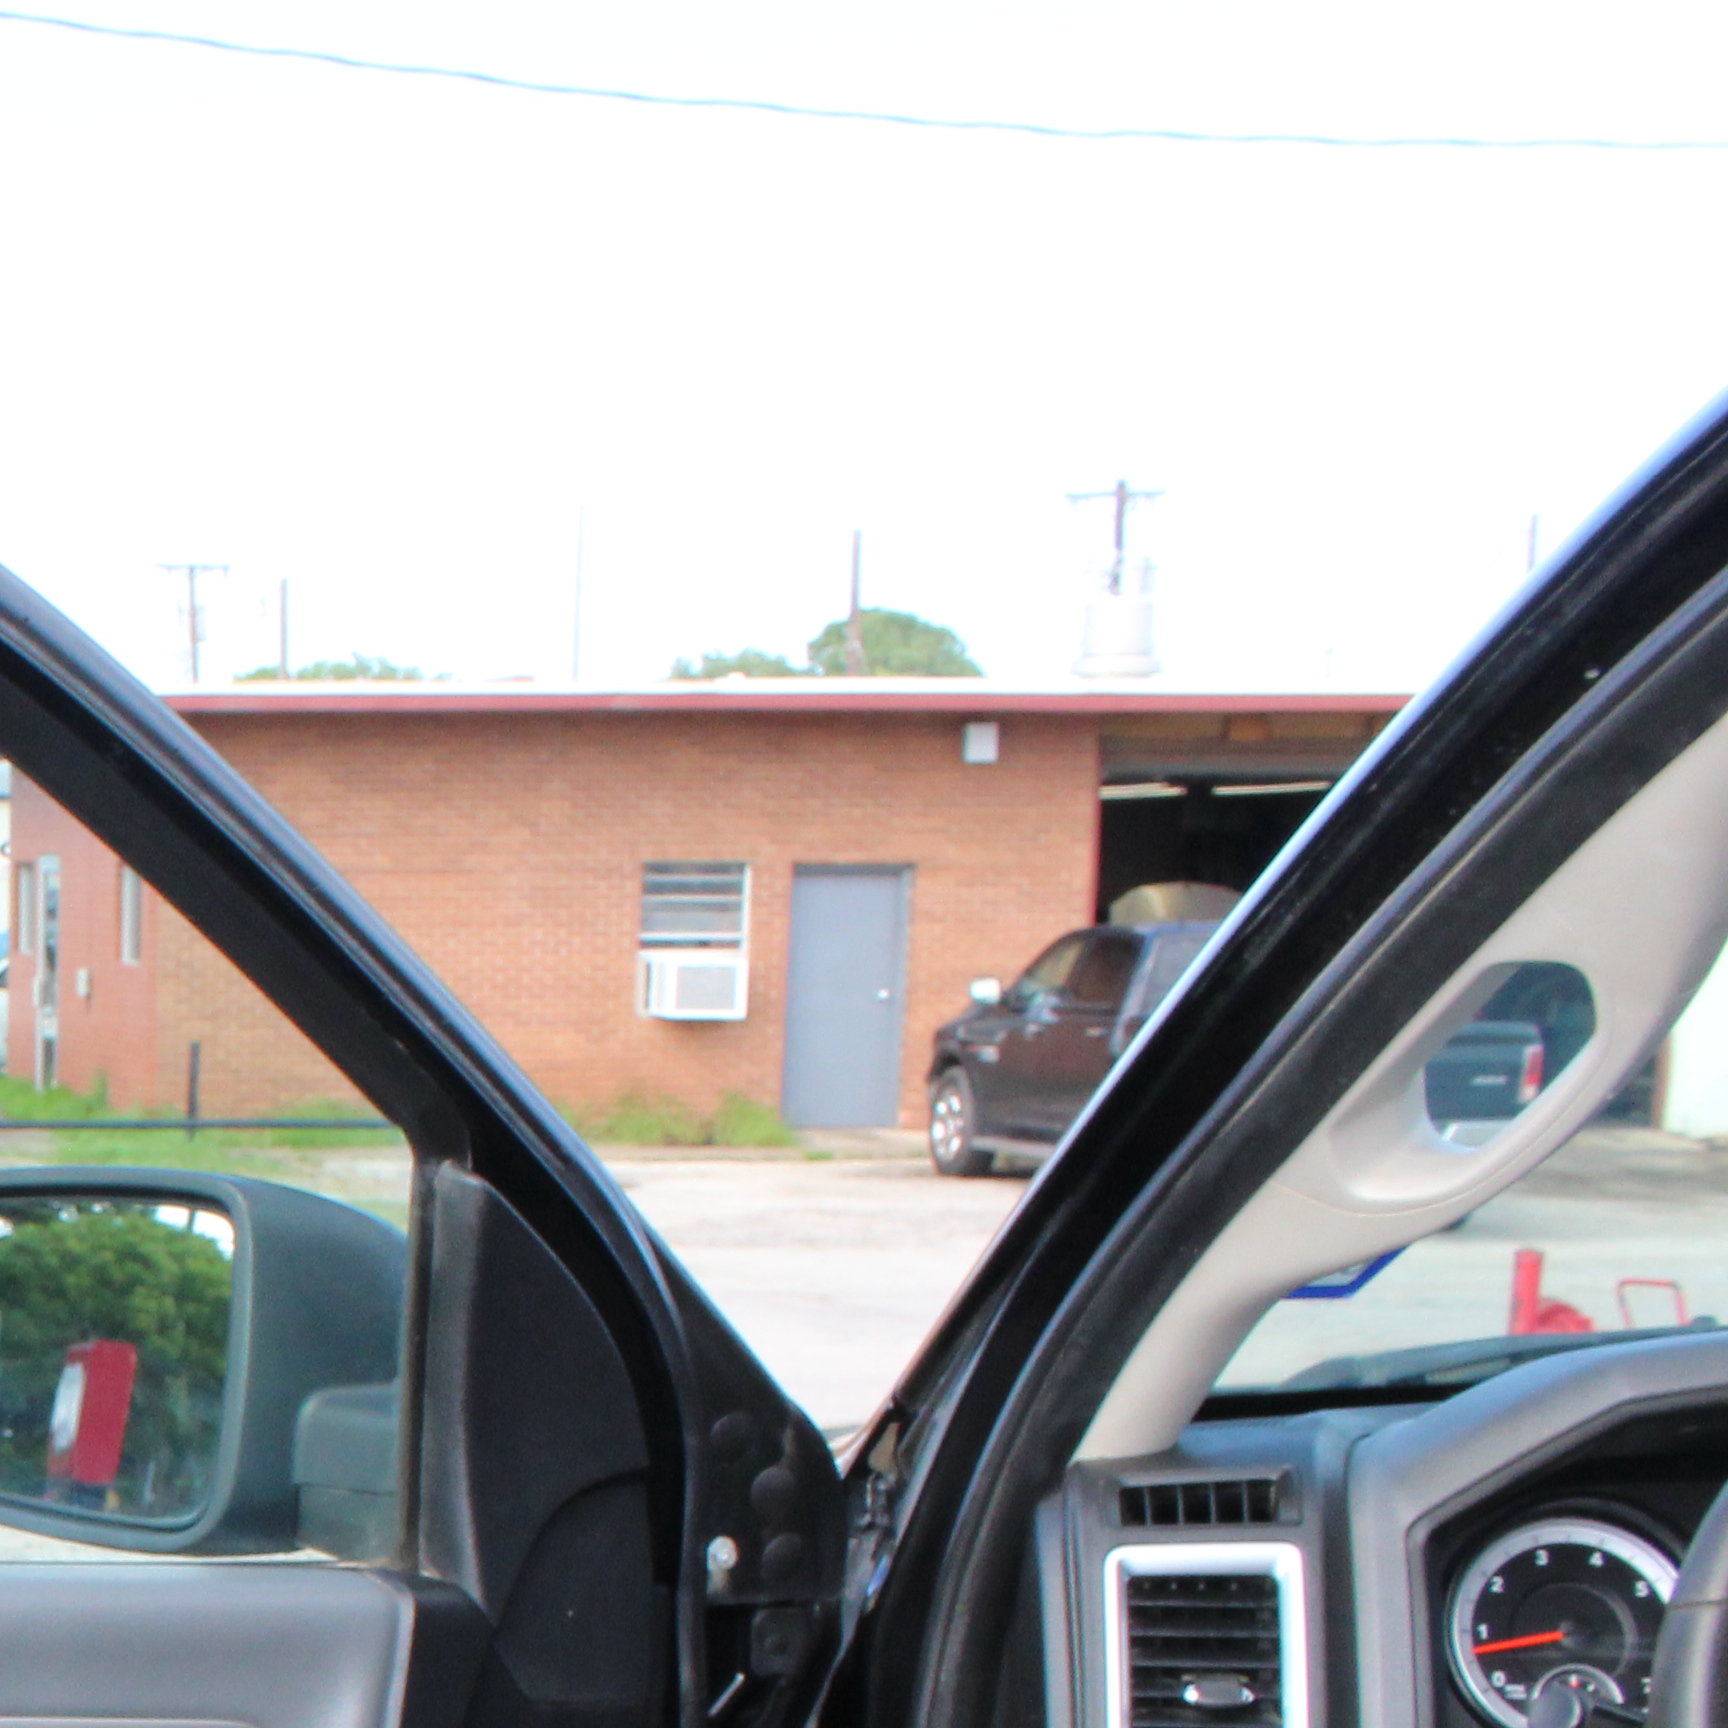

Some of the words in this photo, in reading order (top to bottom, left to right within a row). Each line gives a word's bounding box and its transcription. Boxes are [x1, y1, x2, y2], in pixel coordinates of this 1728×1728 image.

[1534, 1549, 1549, 1567] 3
[1588, 1551, 1605, 1568] 4
[1489, 1576, 1505, 1594] 2
[1634, 1580, 1650, 1598] 5
[1476, 1623, 1489, 1640] 1
[1490, 1671, 1506, 1688] 0
